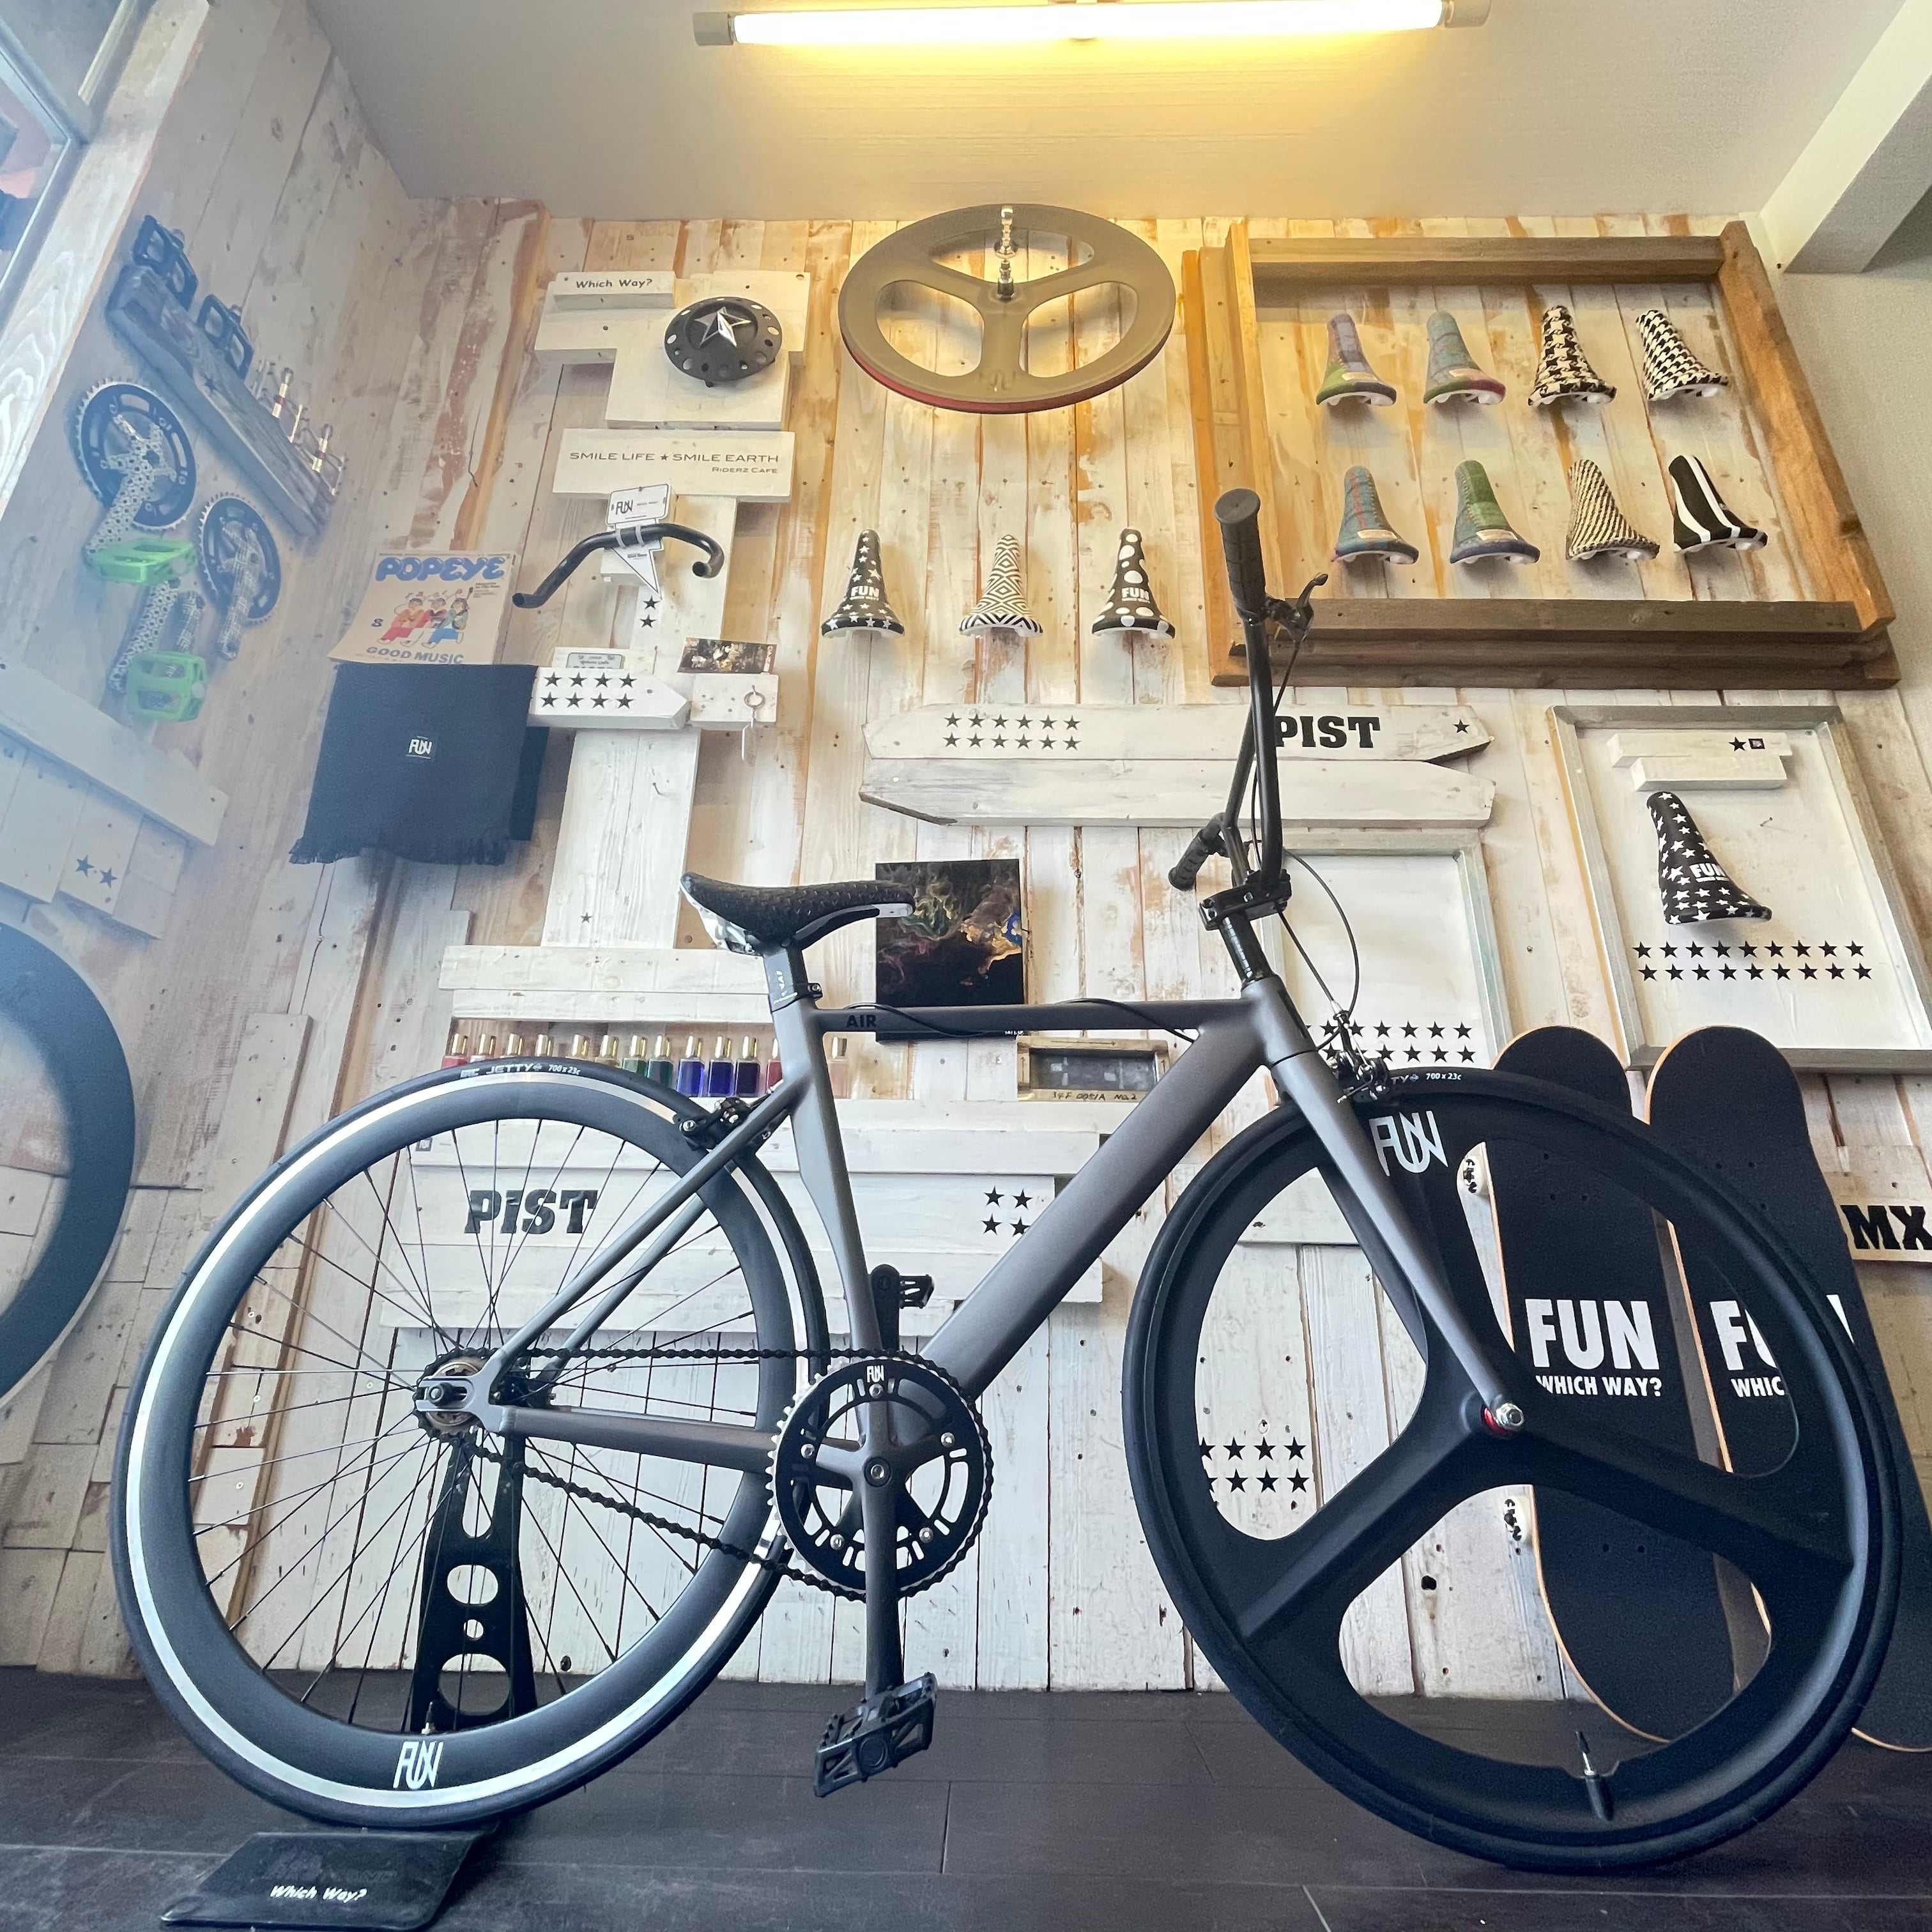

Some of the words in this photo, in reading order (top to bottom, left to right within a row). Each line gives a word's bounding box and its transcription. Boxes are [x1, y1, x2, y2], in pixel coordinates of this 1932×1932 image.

[576, 279, 613, 289] Which
[618, 278, 653, 289] Way?
[570, 452, 618, 461] SMILE
[622, 453, 656, 461] LIFE
[672, 454, 721, 462] SMILE
[725, 454, 779, 463] EARTH
[376, 556, 505, 581] POPEYE
[850, 585, 880, 597] FUN
[1121, 587, 1149, 600] FUN
[366, 647, 412, 659] GOOD
[414, 652, 464, 664] MUSIC
[1275, 715, 1381, 748] PIST
[846, 1014, 877, 1029] AIR
[486, 1063, 534, 1075] JETTY
[464, 1189, 599, 1234] PIST
[1525, 1298, 1660, 1370] FUN
[1535, 1375, 1598, 1395] WHICH
[1602, 1376, 1662, 1397] WAY?
[1731, 1376, 1785, 1398] WHIC
[270, 1885, 318, 1899] Which
[323, 1887, 367, 1903] Way?
